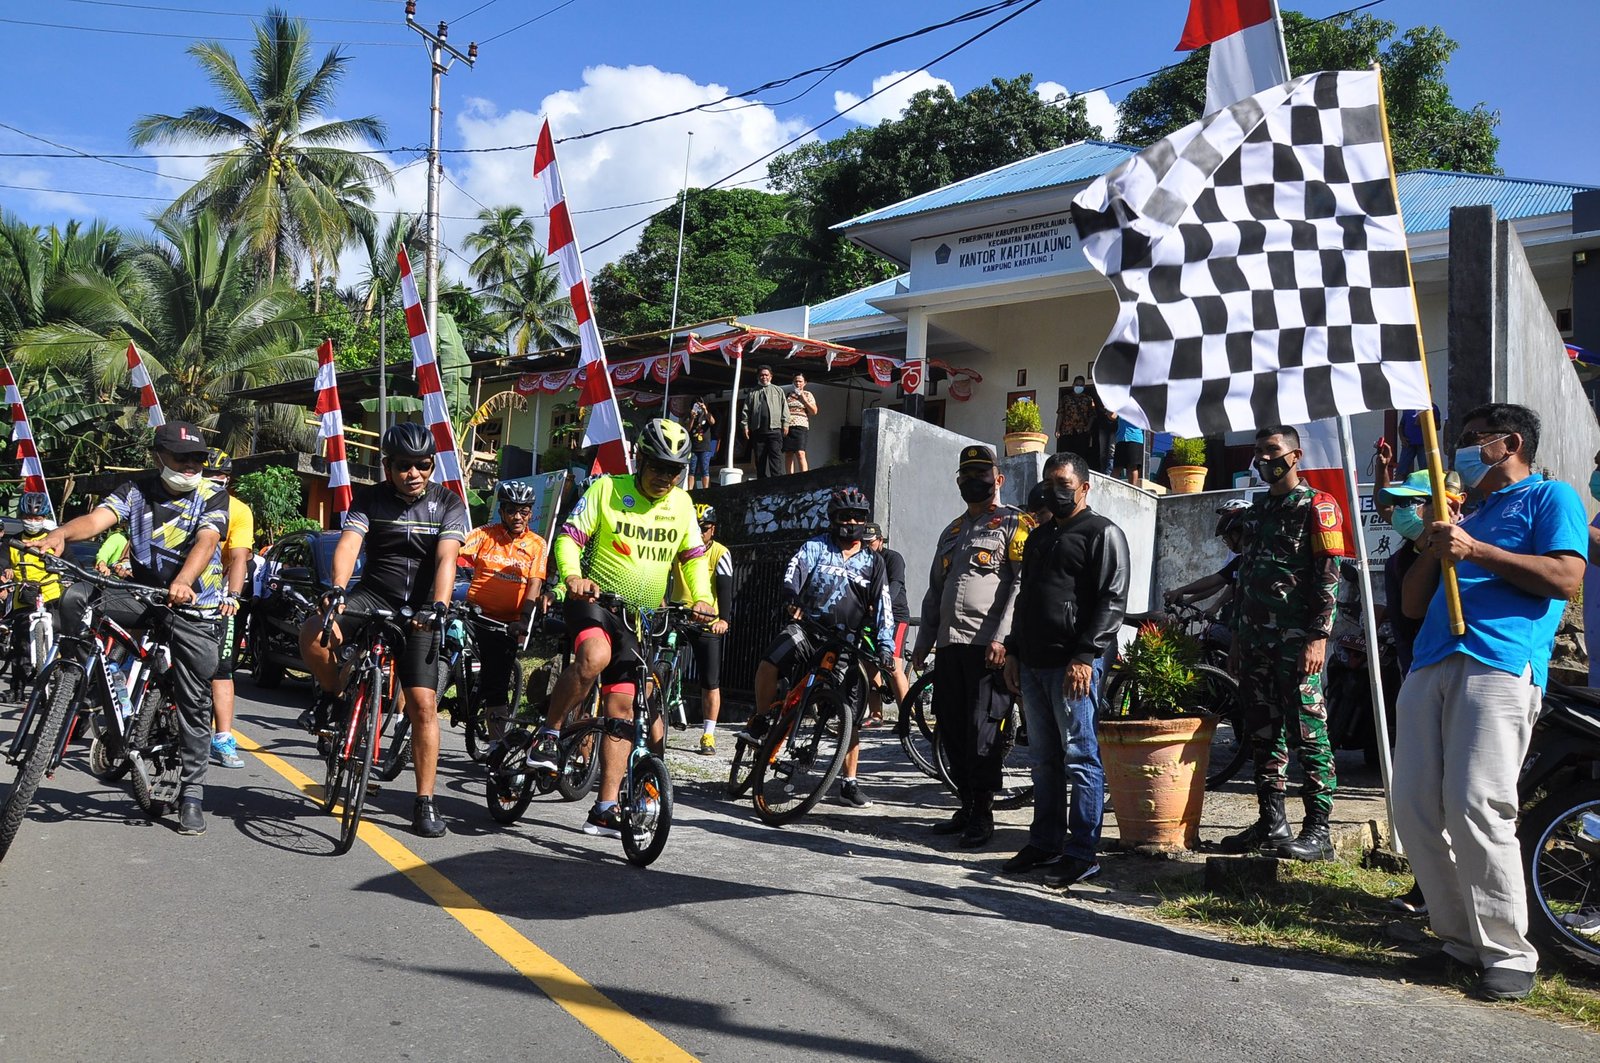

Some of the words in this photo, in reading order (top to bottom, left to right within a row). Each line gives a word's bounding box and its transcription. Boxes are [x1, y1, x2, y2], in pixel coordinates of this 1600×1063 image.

[958, 231, 994, 245] PEMERINTAH
[995, 226, 1030, 239] KABUPATEN
[1030, 218, 1067, 233] KEPULAUAN
[988, 236, 1022, 248] KECAMATAN
[1023, 228, 1059, 241] MANGANITU
[959, 249, 996, 268] KANTOR
[1000, 235, 1072, 261] KAPITALAUNG
[982, 261, 1012, 273] KAMPUNG
[1014, 254, 1048, 268] KARATUNG
[900, 365, 921, 388] 75
[654, 514, 676, 522] Bianchi
[612, 521, 678, 543] JUMBO
[637, 544, 673, 562] VISMA
[817, 563, 871, 588] TREK
